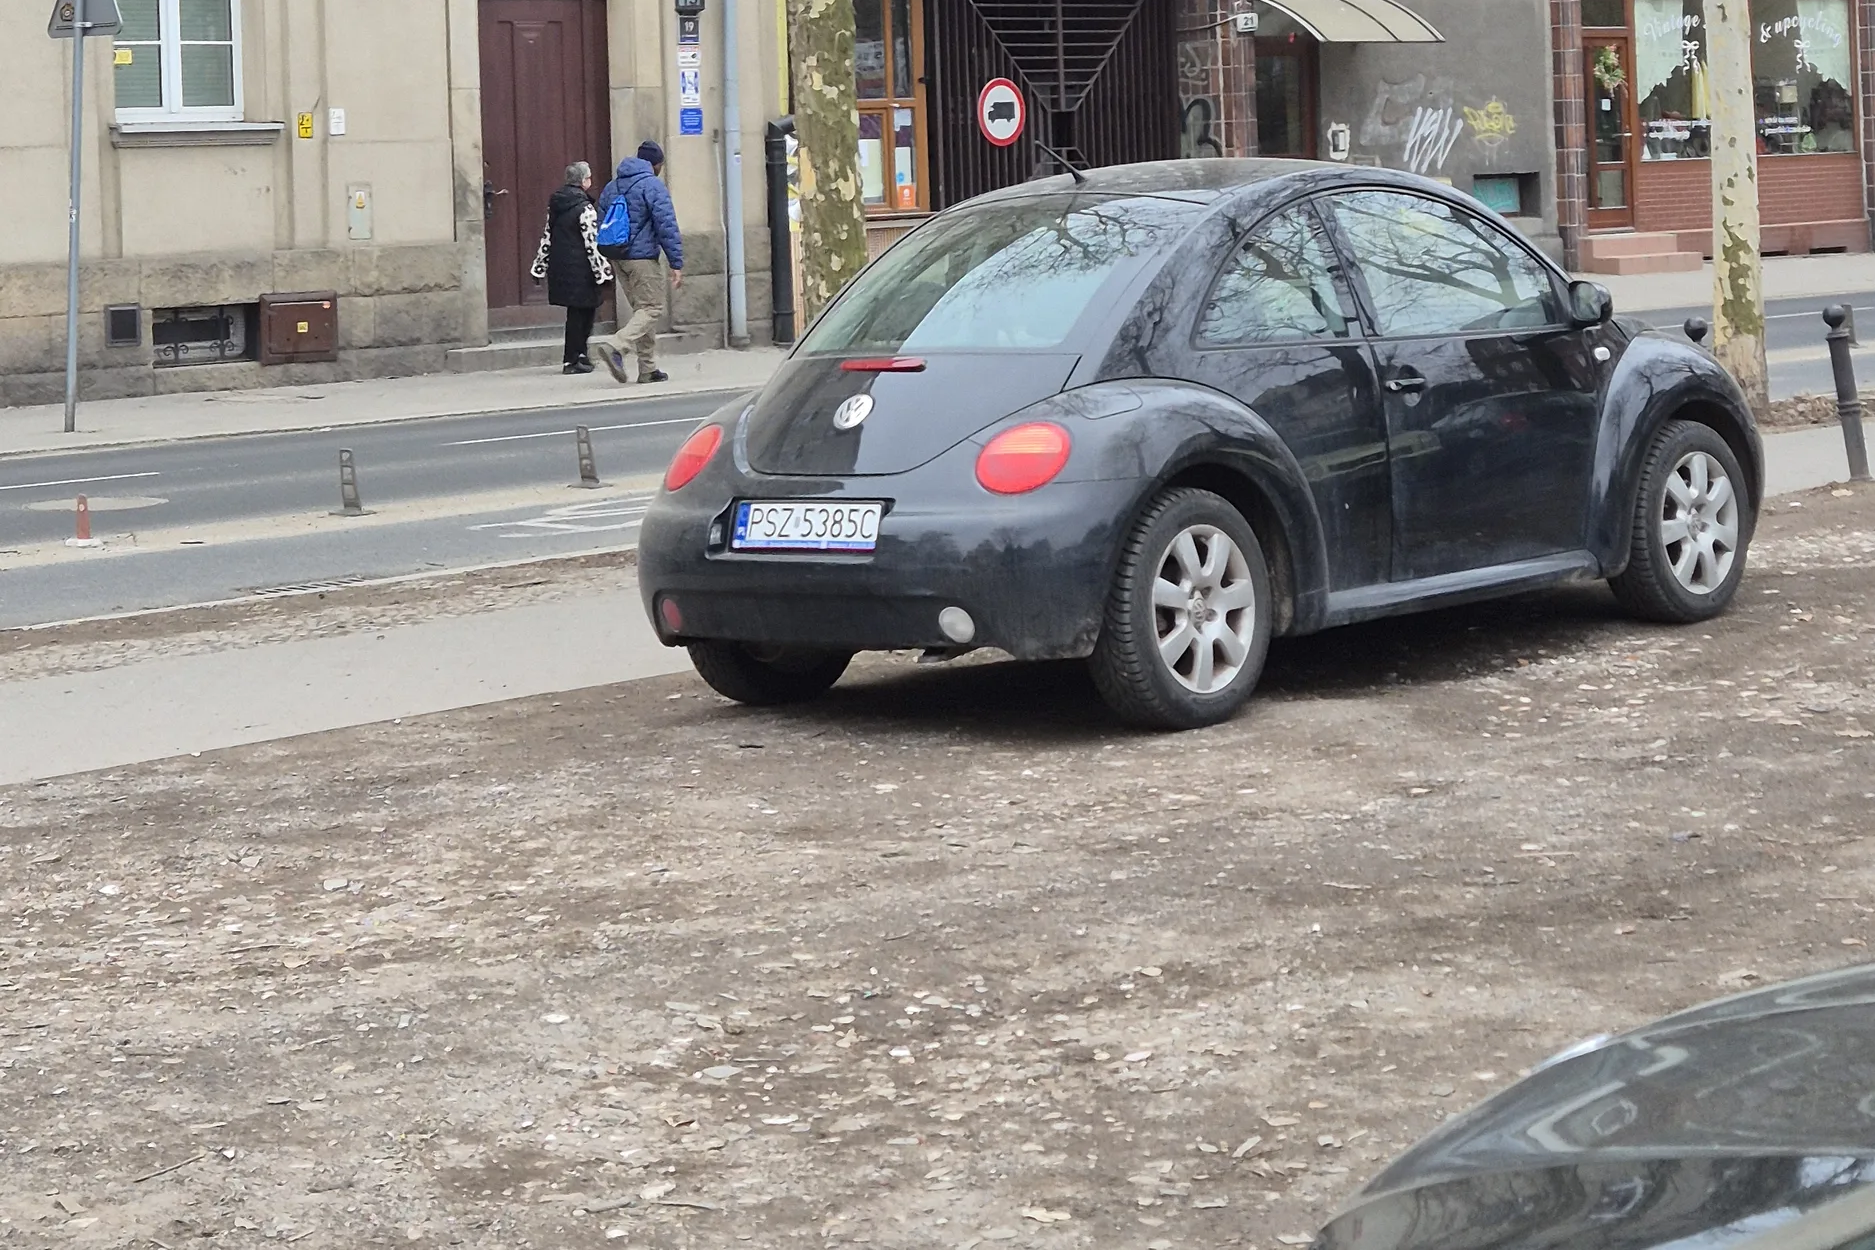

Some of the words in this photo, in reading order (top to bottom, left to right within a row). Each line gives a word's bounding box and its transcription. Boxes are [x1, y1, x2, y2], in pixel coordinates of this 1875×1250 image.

[684, 21, 695, 32] 19
[1243, 16, 1254, 26] 21
[1643, 14, 1701, 41] Vintage
[1760, 22, 1772, 43] &
[1774, 11, 1842, 48] upcycling
[749, 508, 795, 538] PSZ
[801, 508, 877, 539] 5385C
